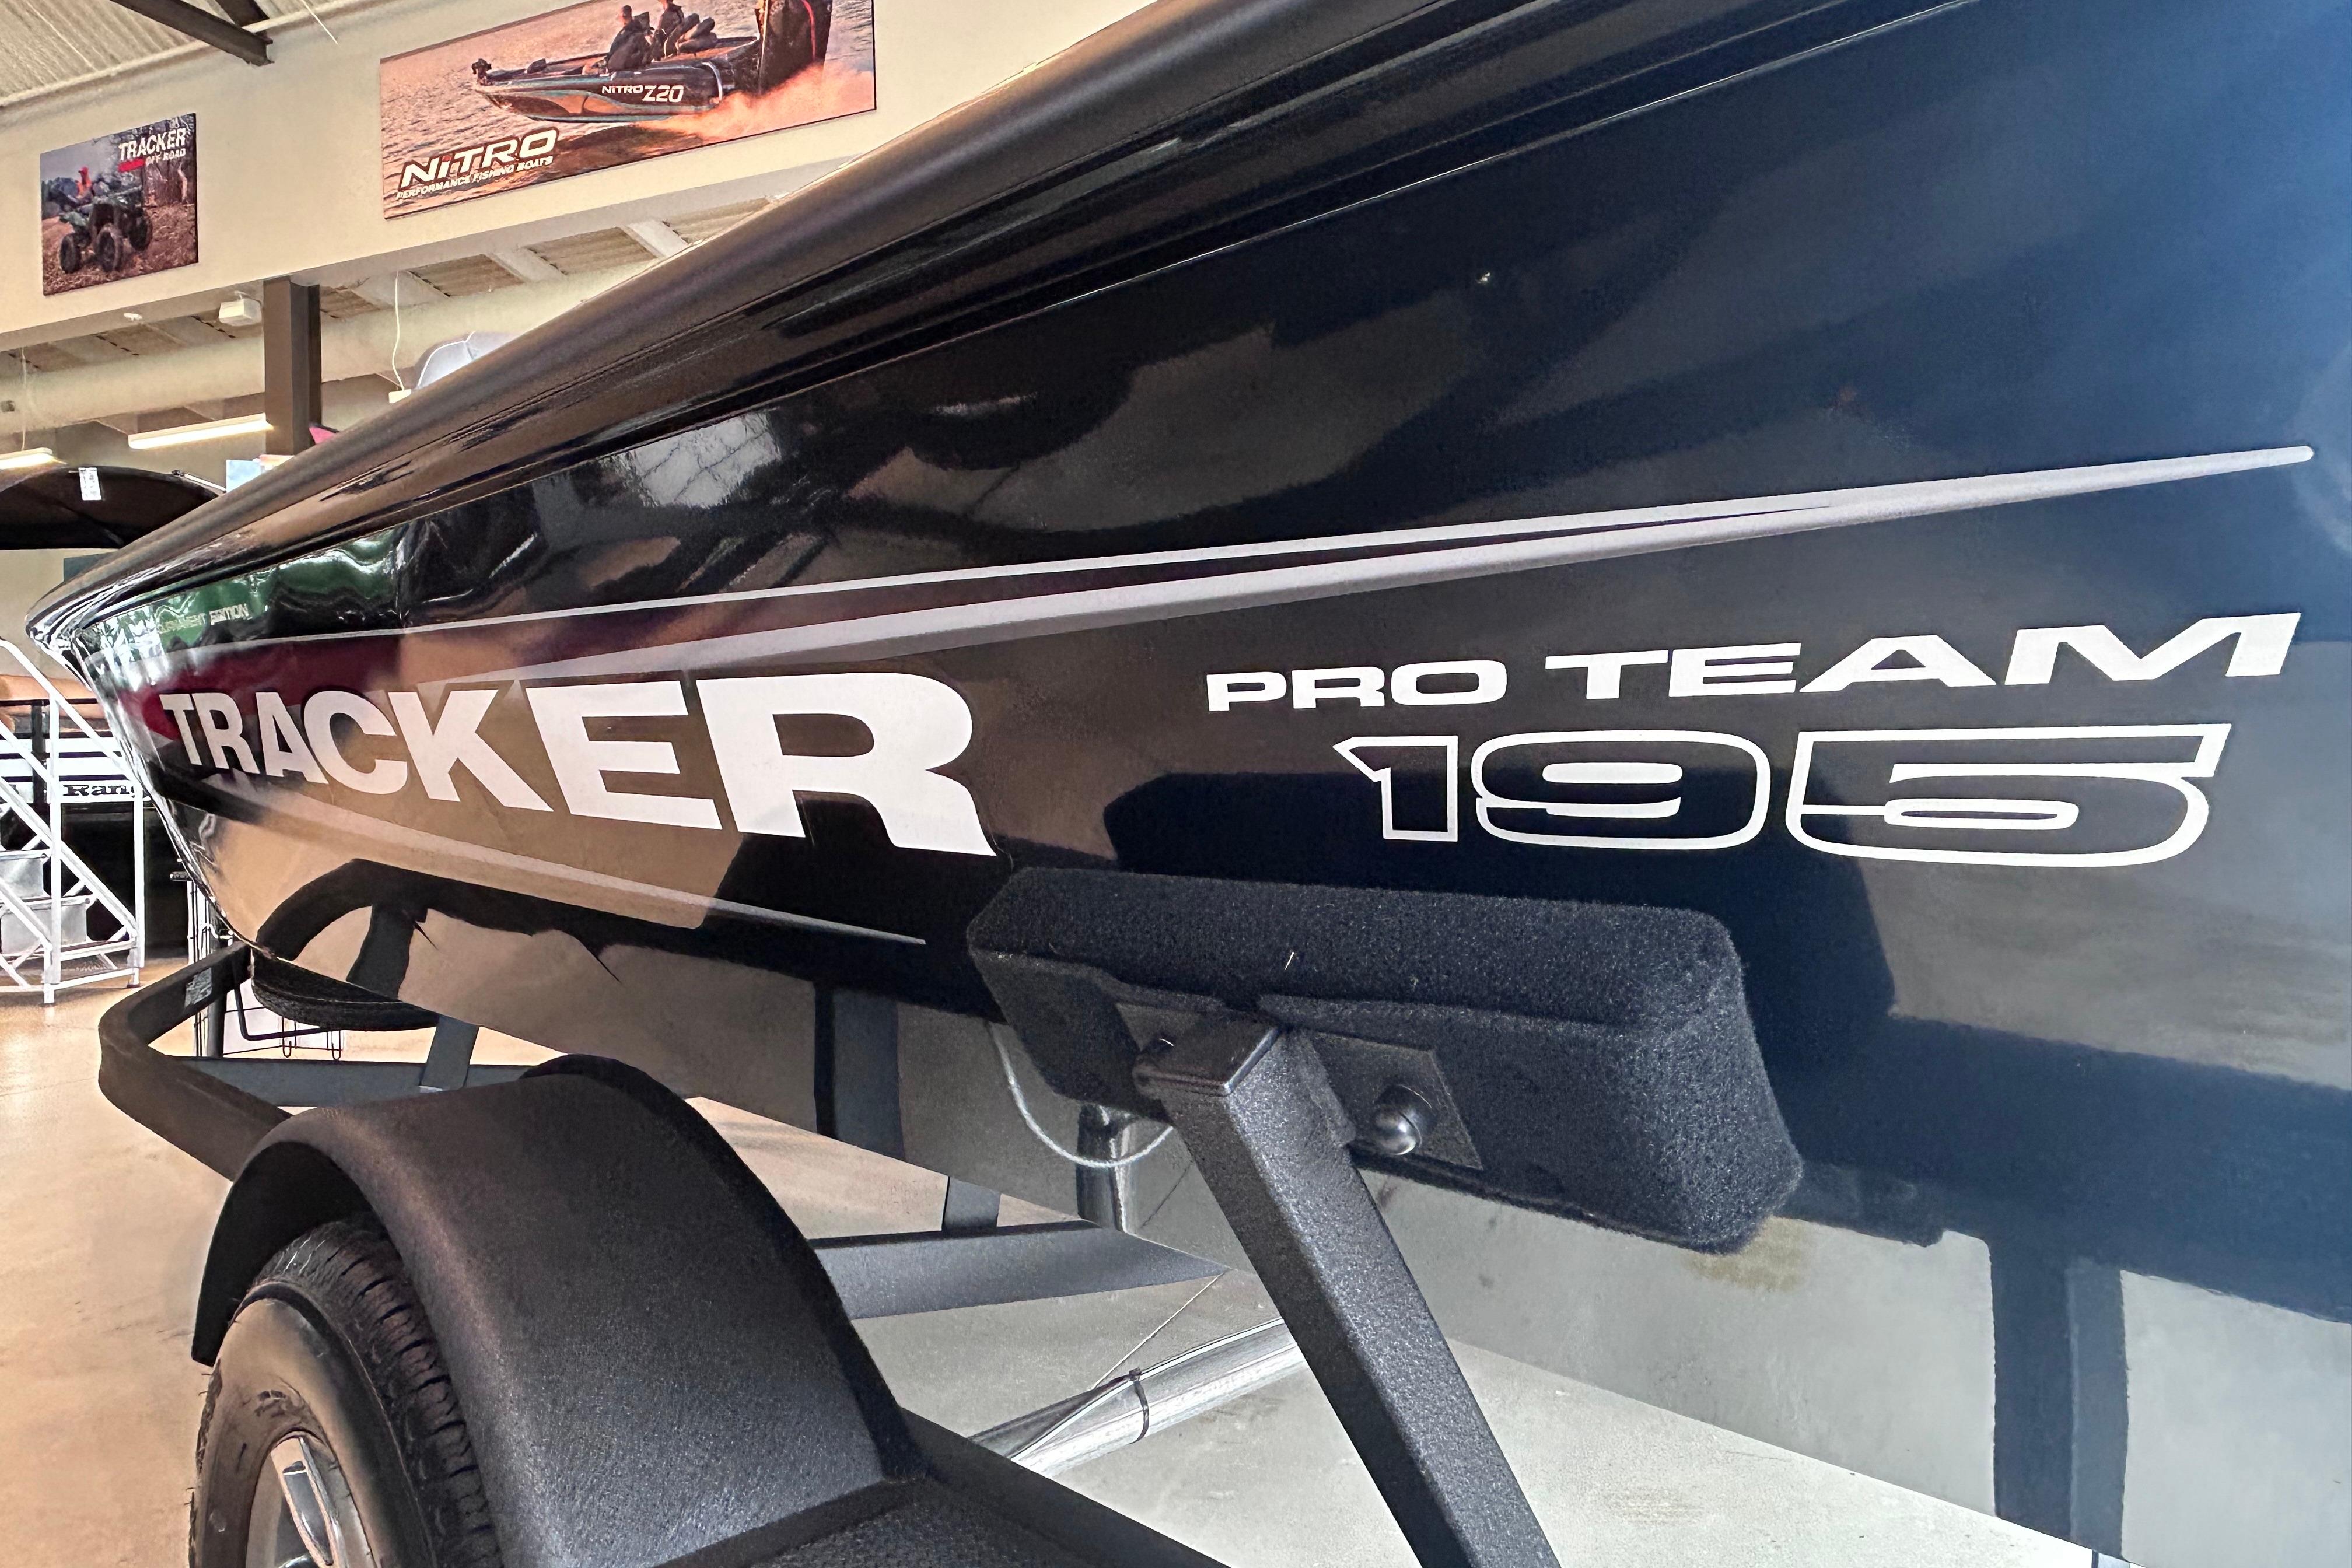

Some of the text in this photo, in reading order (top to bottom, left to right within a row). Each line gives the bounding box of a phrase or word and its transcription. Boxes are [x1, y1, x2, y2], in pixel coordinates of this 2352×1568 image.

[642, 85, 684, 103] Z20
[118, 128, 186, 160] TRACKER
[163, 148, 186, 160] ROAD
[397, 156, 554, 200] PERFORMANCE FISHING BOATS
[1207, 612, 2301, 711] PRO TEAM
[160, 672, 996, 856] TRACKER
[1332, 723, 2232, 868] 195
